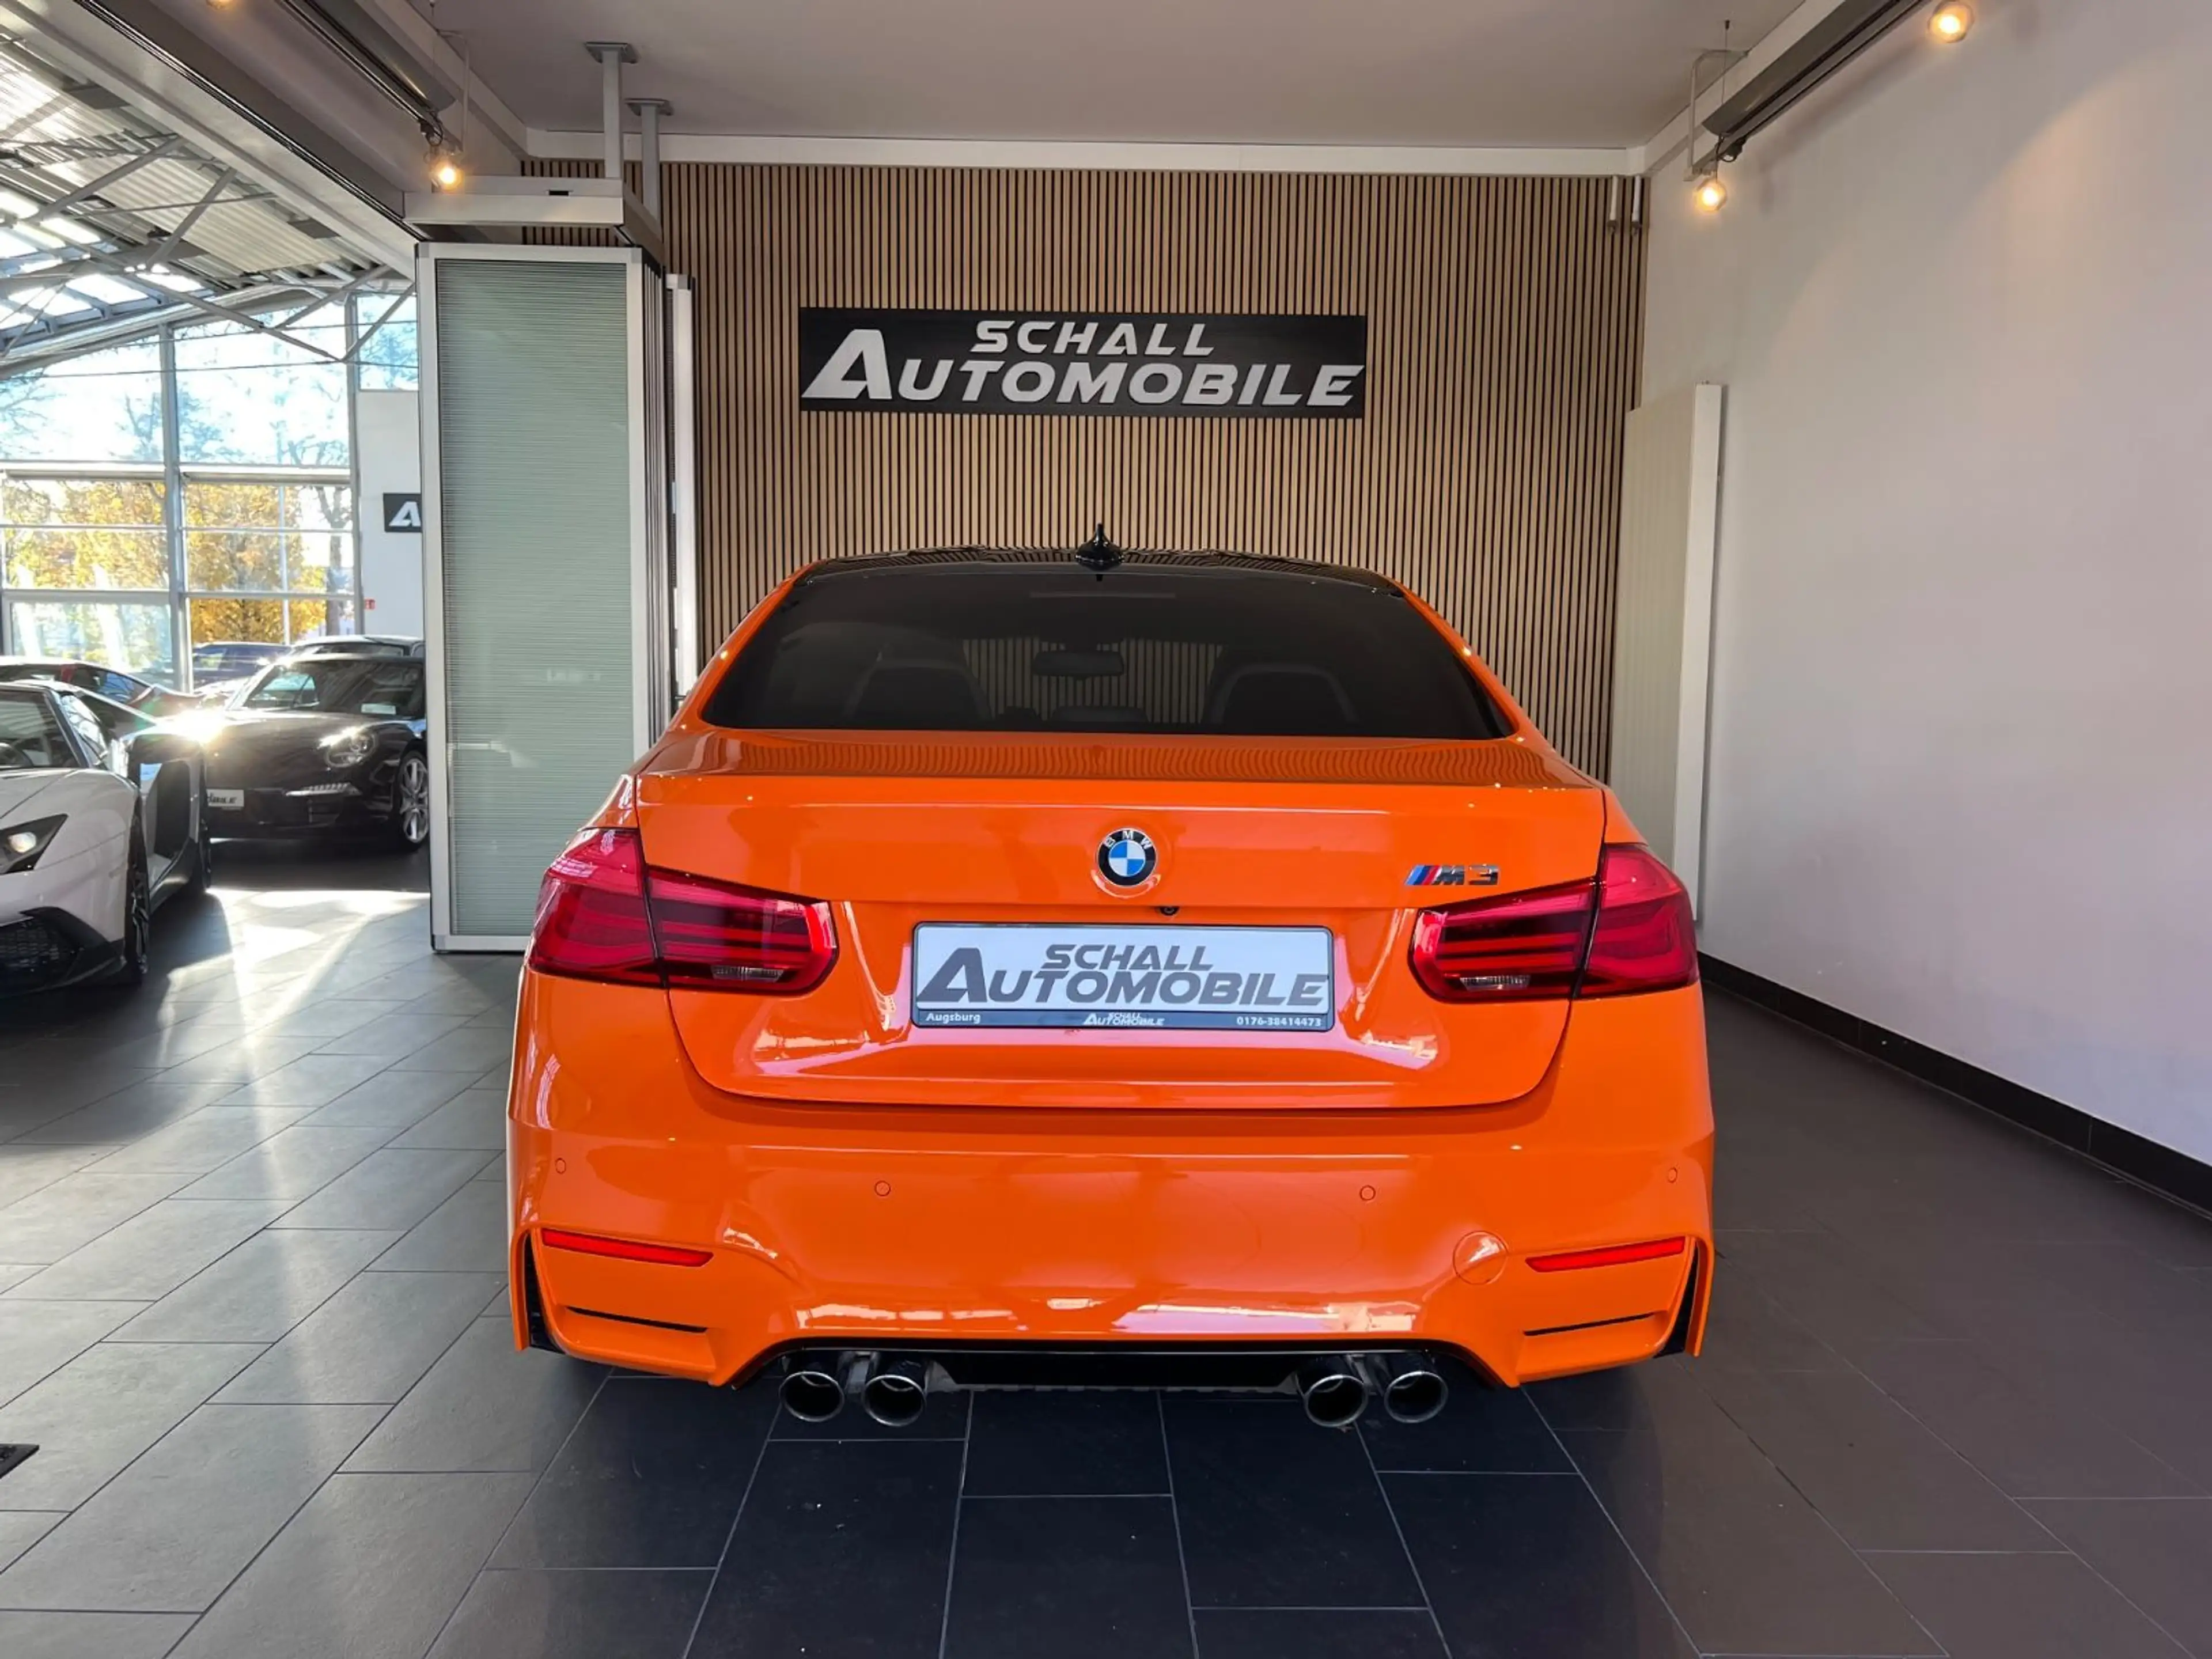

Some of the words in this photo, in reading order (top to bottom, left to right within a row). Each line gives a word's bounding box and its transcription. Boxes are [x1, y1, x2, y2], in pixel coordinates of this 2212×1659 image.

[971, 320, 1214, 357] SCHALL
[801, 329, 1365, 406] AUTOMOBILE
[1103, 830, 1153, 850] BMW
[1431, 864, 1499, 885] M3
[1041, 944, 1213, 971] SCHALL
[916, 948, 1328, 1006] AUTOMOBILE
[926, 1013, 980, 1024] Augsburg
